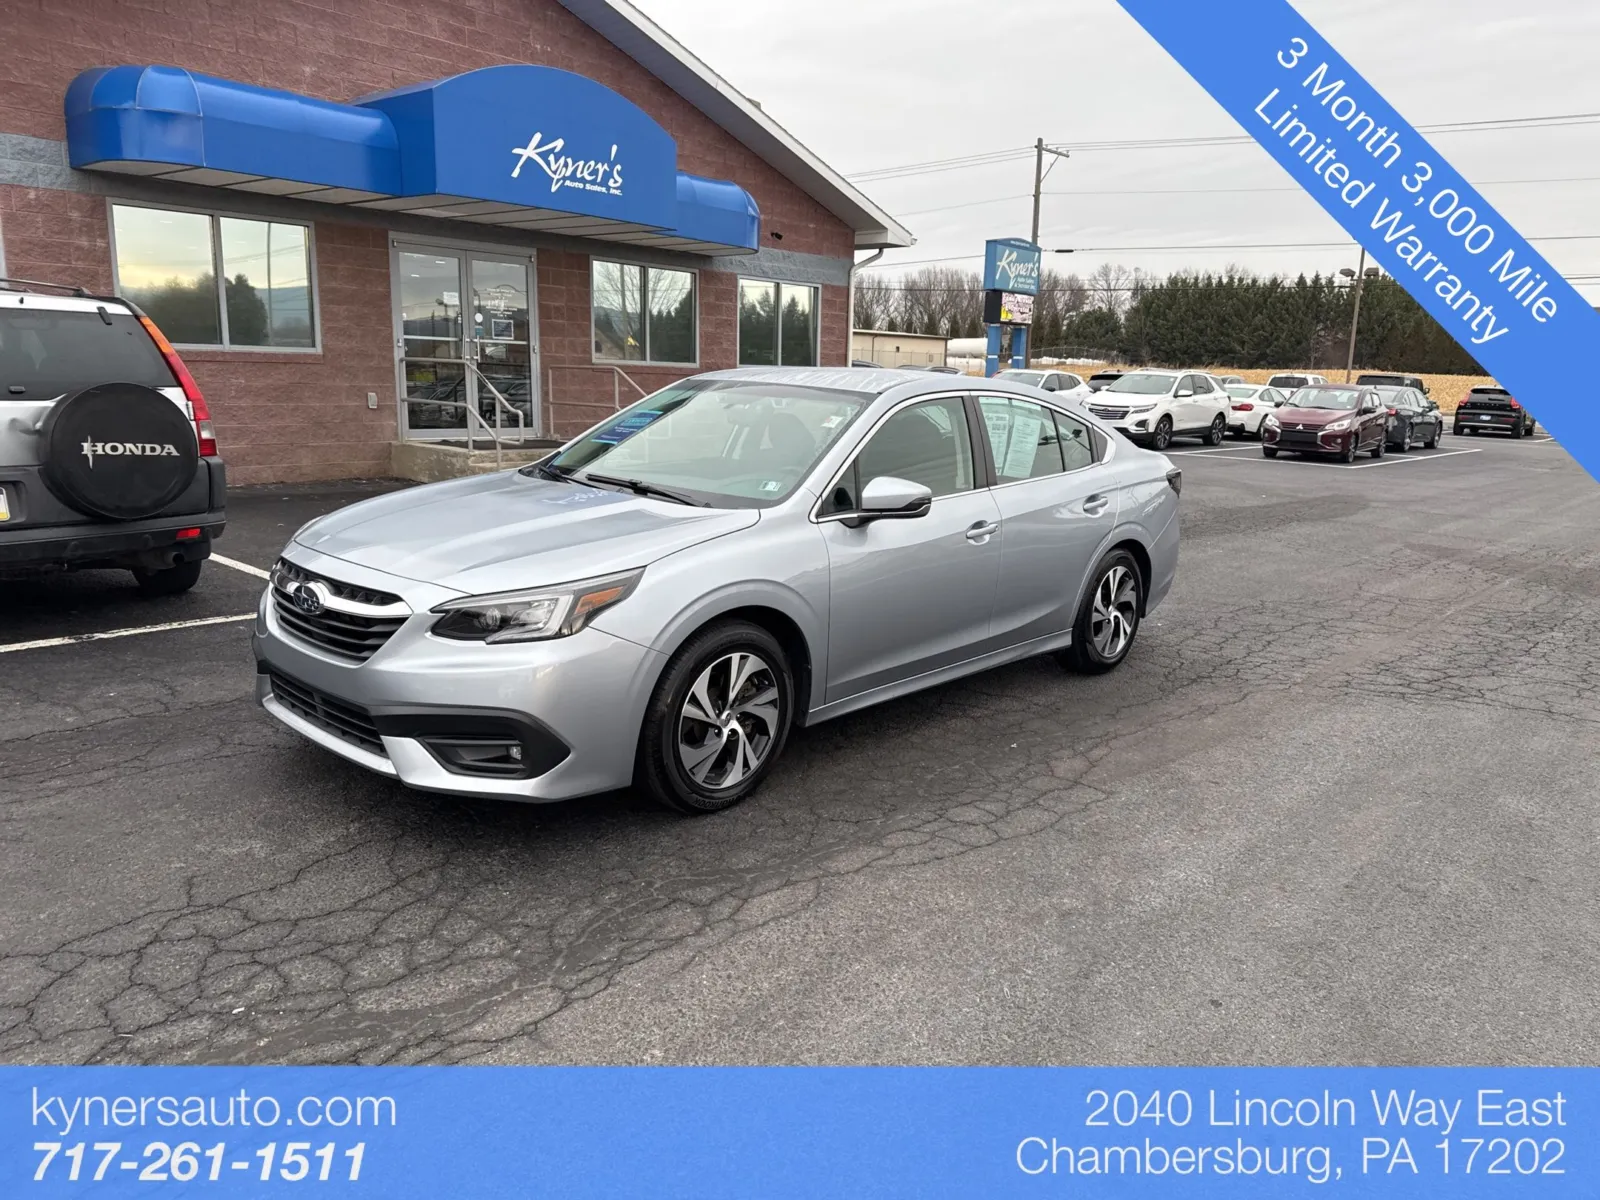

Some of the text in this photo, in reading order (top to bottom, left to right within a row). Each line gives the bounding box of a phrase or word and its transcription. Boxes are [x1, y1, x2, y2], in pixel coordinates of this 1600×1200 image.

[511, 131, 623, 193] Kyner's
[564, 179, 584, 189] Auto
[585, 183, 608, 194] Sales,
[996, 248, 1039, 290] Kyner's
[81, 441, 180, 457] HONDA
